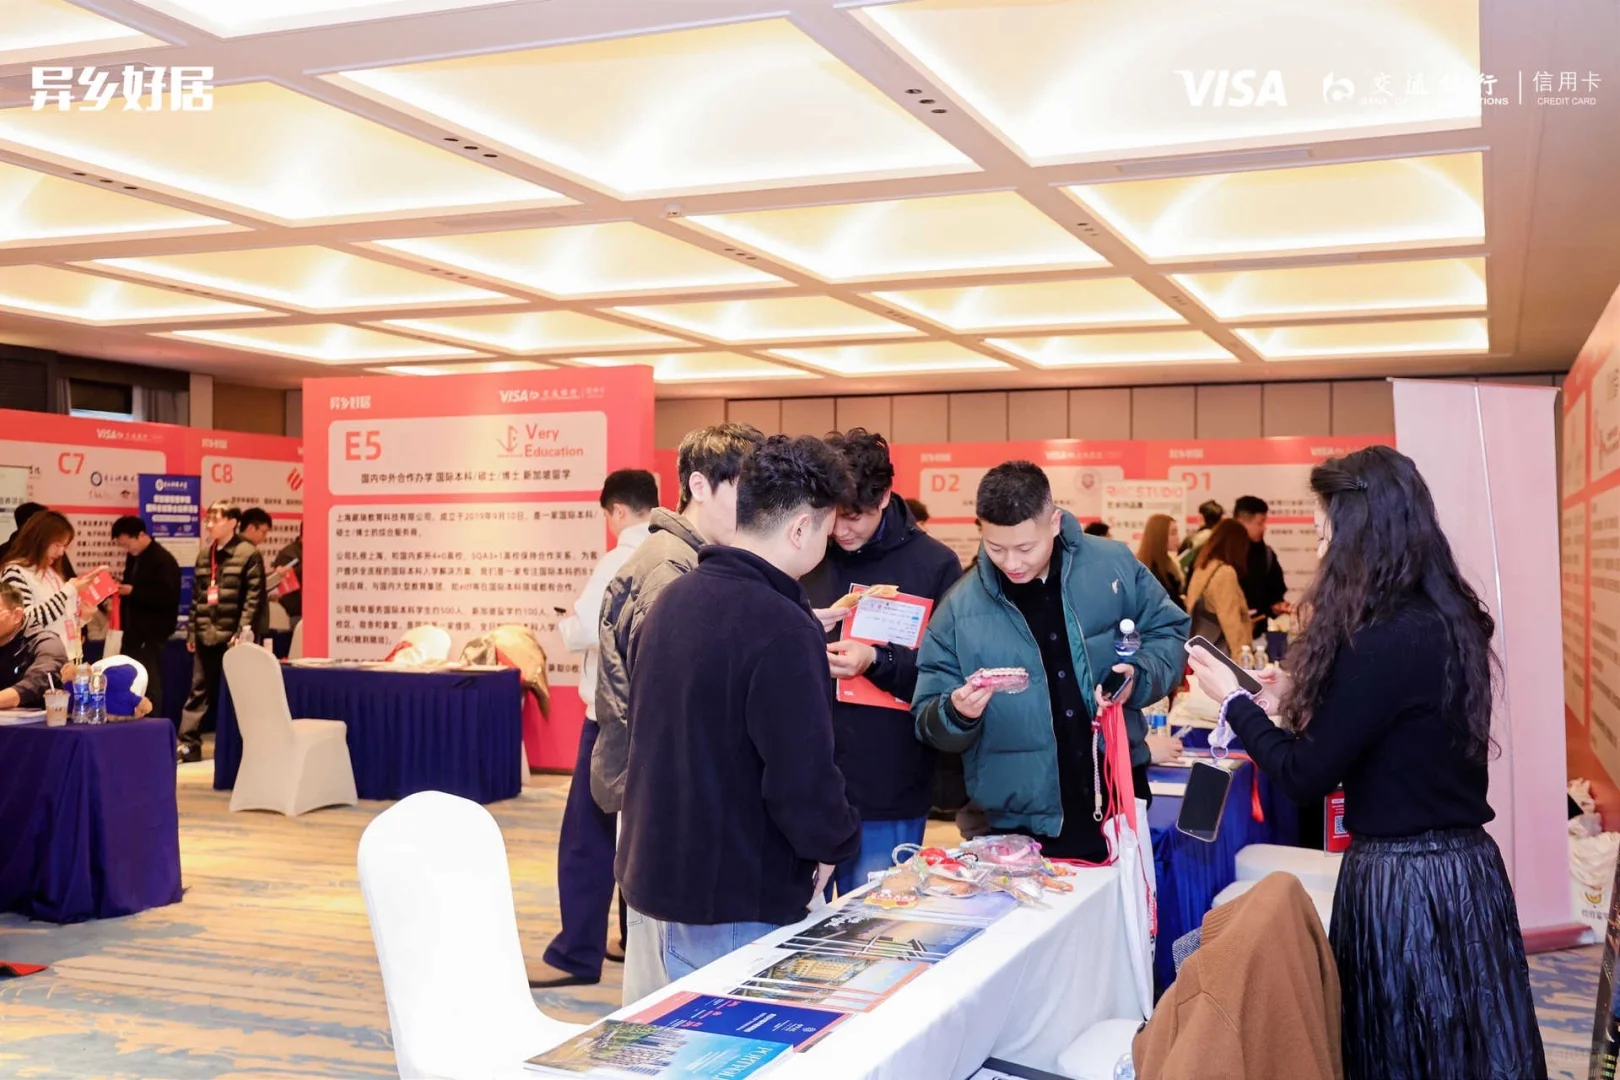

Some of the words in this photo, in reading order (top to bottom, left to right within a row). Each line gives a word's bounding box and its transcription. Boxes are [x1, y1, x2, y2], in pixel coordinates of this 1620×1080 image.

[499, 389, 530, 404] VISA
[525, 423, 559, 443] Very
[344, 430, 382, 461] E5
[524, 443, 584, 457] Education
[57, 452, 85, 475] C7
[211, 462, 233, 484] C8
[930, 474, 961, 492] D2
